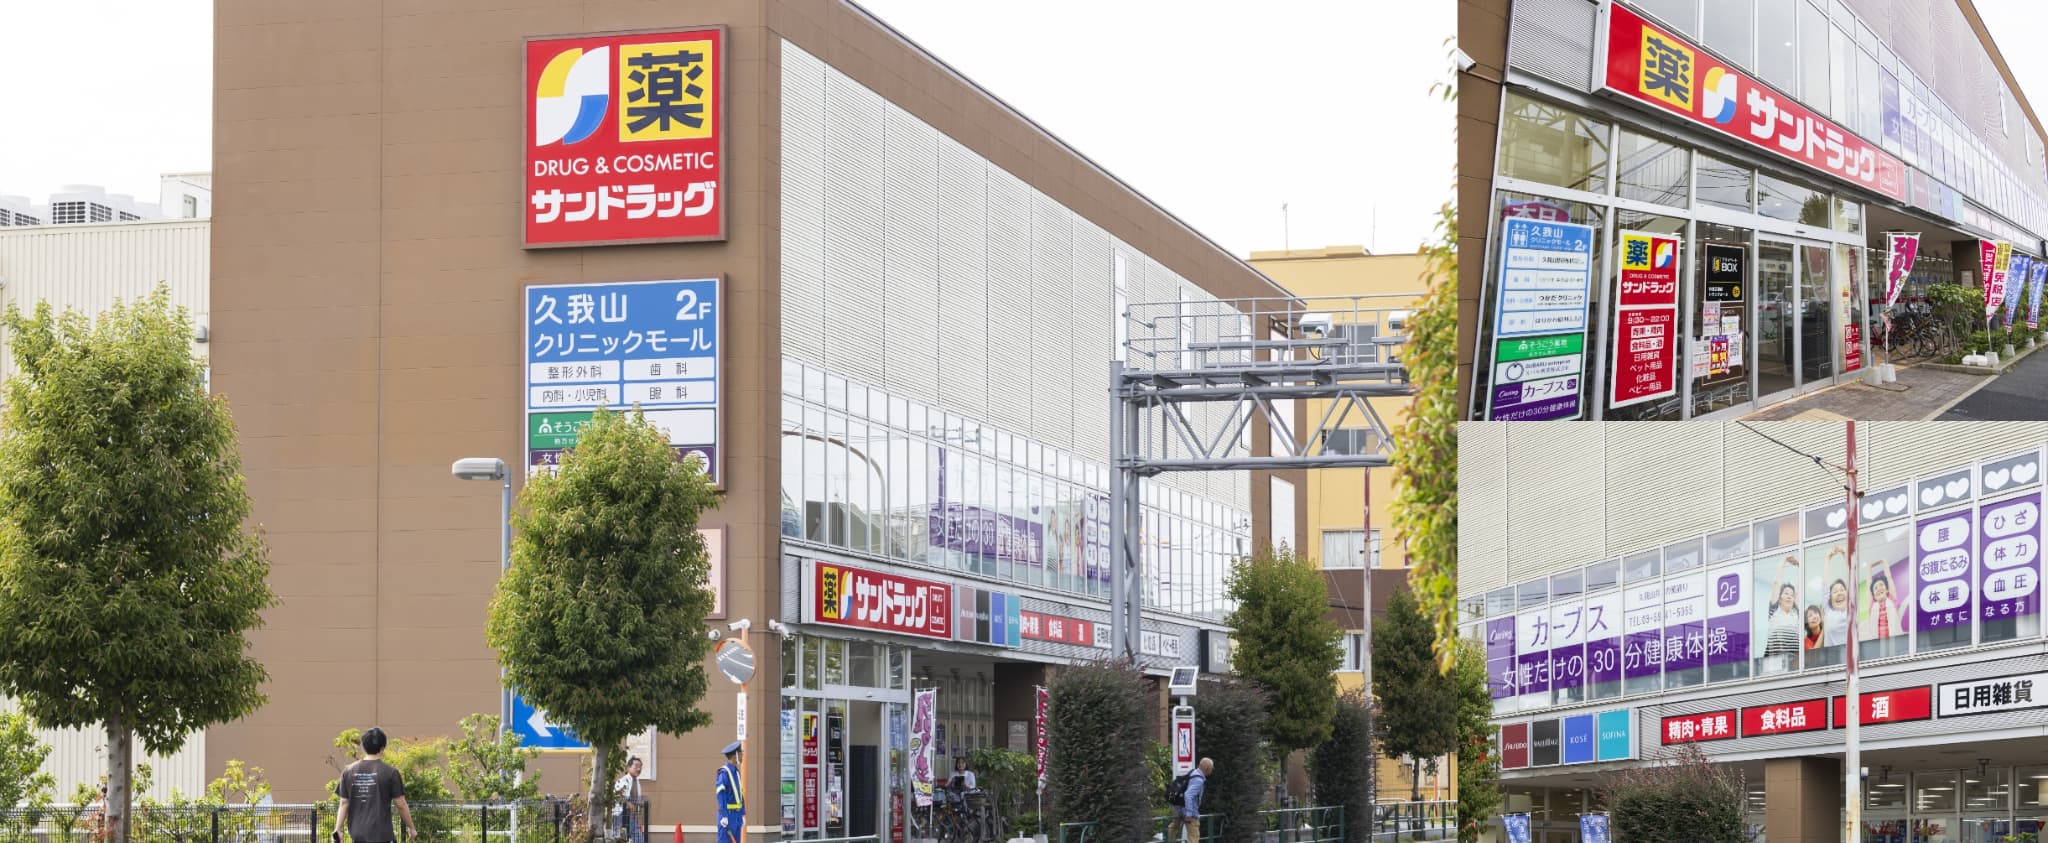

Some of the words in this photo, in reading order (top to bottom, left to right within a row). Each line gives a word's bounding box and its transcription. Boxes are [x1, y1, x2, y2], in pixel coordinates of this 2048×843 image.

[1645, 36, 1690, 106] 薬
[626, 49, 704, 135] 薬
[1746, 87, 1876, 183] サンドラッグ
[534, 158, 590, 177] DRUG
[595, 156, 610, 175] &
[613, 151, 714, 174] COSMETIC
[531, 180, 717, 224] サンドラッグ
[1531, 226, 1564, 239] 久我山
[1626, 239, 1649, 266] 薬
[1985, 248, 1996, 263] Tax
[1721, 262, 1738, 273] BOX
[1622, 281, 1675, 294] サンドラッグ
[534, 292, 628, 326] 久我山
[675, 289, 712, 321] 2F
[534, 327, 712, 357] クリニックモール
[548, 365, 602, 379] 整形外科
[650, 361, 688, 377] 歯科
[542, 388, 608, 403] 内科・小児科
[650, 386, 688, 400] 眼科
[1523, 381, 1565, 399] カーブス
[1993, 508, 2028, 530] ひざ
[1937, 527, 1950, 543] 腰
[1994, 542, 2028, 562] 体力
[1920, 554, 1968, 576] お腹たるみ
[823, 571, 837, 614] 薬
[1720, 582, 1737, 601] 2F
[1994, 573, 2028, 593] 血圧
[856, 575, 928, 628] サンドラッグ
[1928, 587, 1960, 605] 体重
[1930, 610, 1968, 626] が気に
[1984, 602, 2025, 618] なる方
[1530, 605, 1608, 648] カーブス
[1502, 626, 1728, 691] 女性だけの30分健康体操
[1954, 680, 2033, 710] 日用雑貨
[1871, 695, 1890, 719] 酒
[1668, 716, 1728, 740] 精肉・青果
[1761, 706, 1806, 731] 食料品
[1602, 730, 1626, 741] SOFINA
